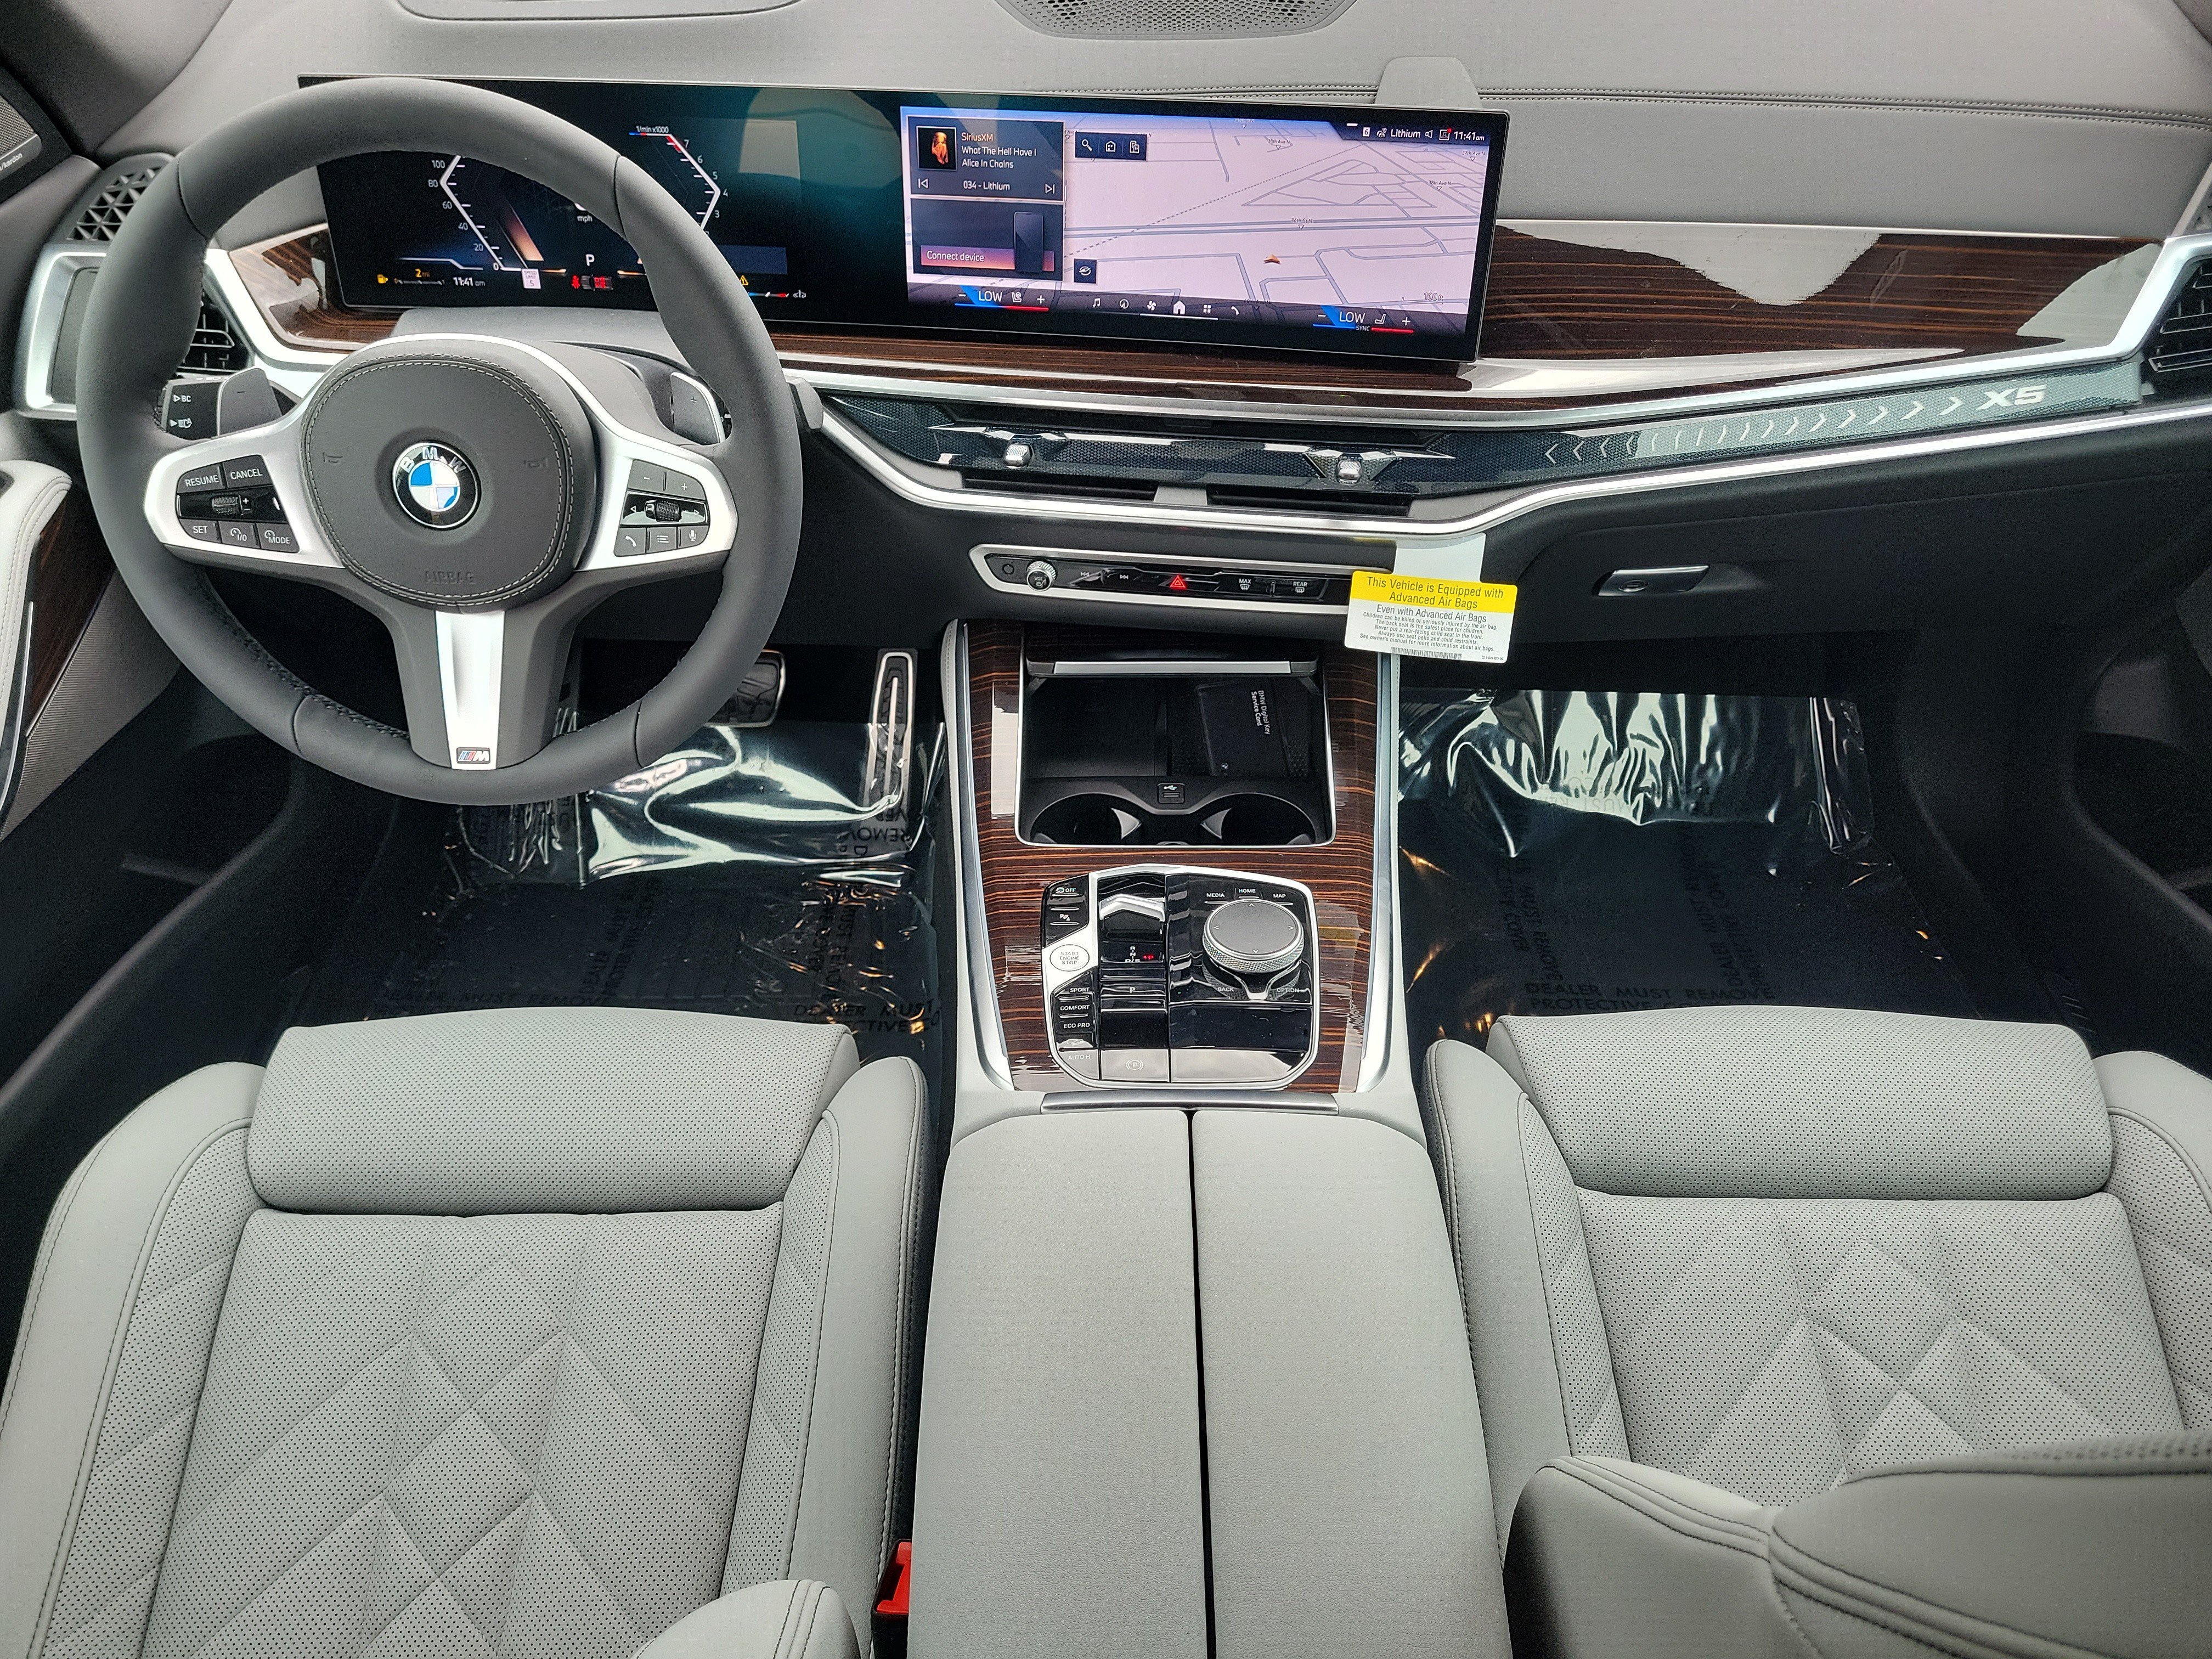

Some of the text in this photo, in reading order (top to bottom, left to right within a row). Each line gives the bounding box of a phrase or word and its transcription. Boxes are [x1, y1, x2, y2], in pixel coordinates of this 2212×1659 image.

[961, 132, 994, 142] SiriusXM
[1390, 128, 1421, 138] Lithium
[684, 139, 690, 148] 7
[961, 146, 981, 155] What
[981, 146, 996, 155] The
[997, 147, 1012, 156] Hell
[1013, 148, 1033, 156] Have
[431, 160, 445, 168] 100
[697, 155, 703, 163] 6
[962, 158, 979, 167] Alice
[989, 159, 1014, 168] Chains
[713, 171, 718, 180] 5
[428, 179, 438, 188] 80
[963, 180, 1010, 190] 034 Lithium
[723, 189, 729, 198] 4
[714, 210, 720, 218] 3
[458, 222, 468, 230] 40
[473, 243, 483, 251] 20
[585, 254, 595, 267] P
[927, 250, 985, 262] Connect device
[415, 268, 422, 278] 2
[453, 277, 473, 286] 11:41
[978, 290, 1003, 302] LOW
[1424, 292, 1438, 301] 100
[1339, 311, 1366, 323] LOW
[1976, 384, 2047, 410] X5
[399, 446, 466, 474] BMW
[230, 468, 263, 480] CANCEL
[184, 475, 219, 487] RESUME
[193, 525, 208, 533] SET
[1367, 576, 1503, 599] This Vehicle is Equipped with
[1389, 591, 1478, 610] Advanced Air Bags
[1376, 604, 1487, 624] Even with Advanced Air Bags
[1404, 628, 1430, 636] rear-facing
[1258, 690, 1266, 705] BMW
[1251, 691, 1263, 726] Service Card
[1261, 706, 1270, 724] Digital
[472, 751, 490, 761] M
[1525, 983, 1775, 1000] DEALER MUST REMOVE
